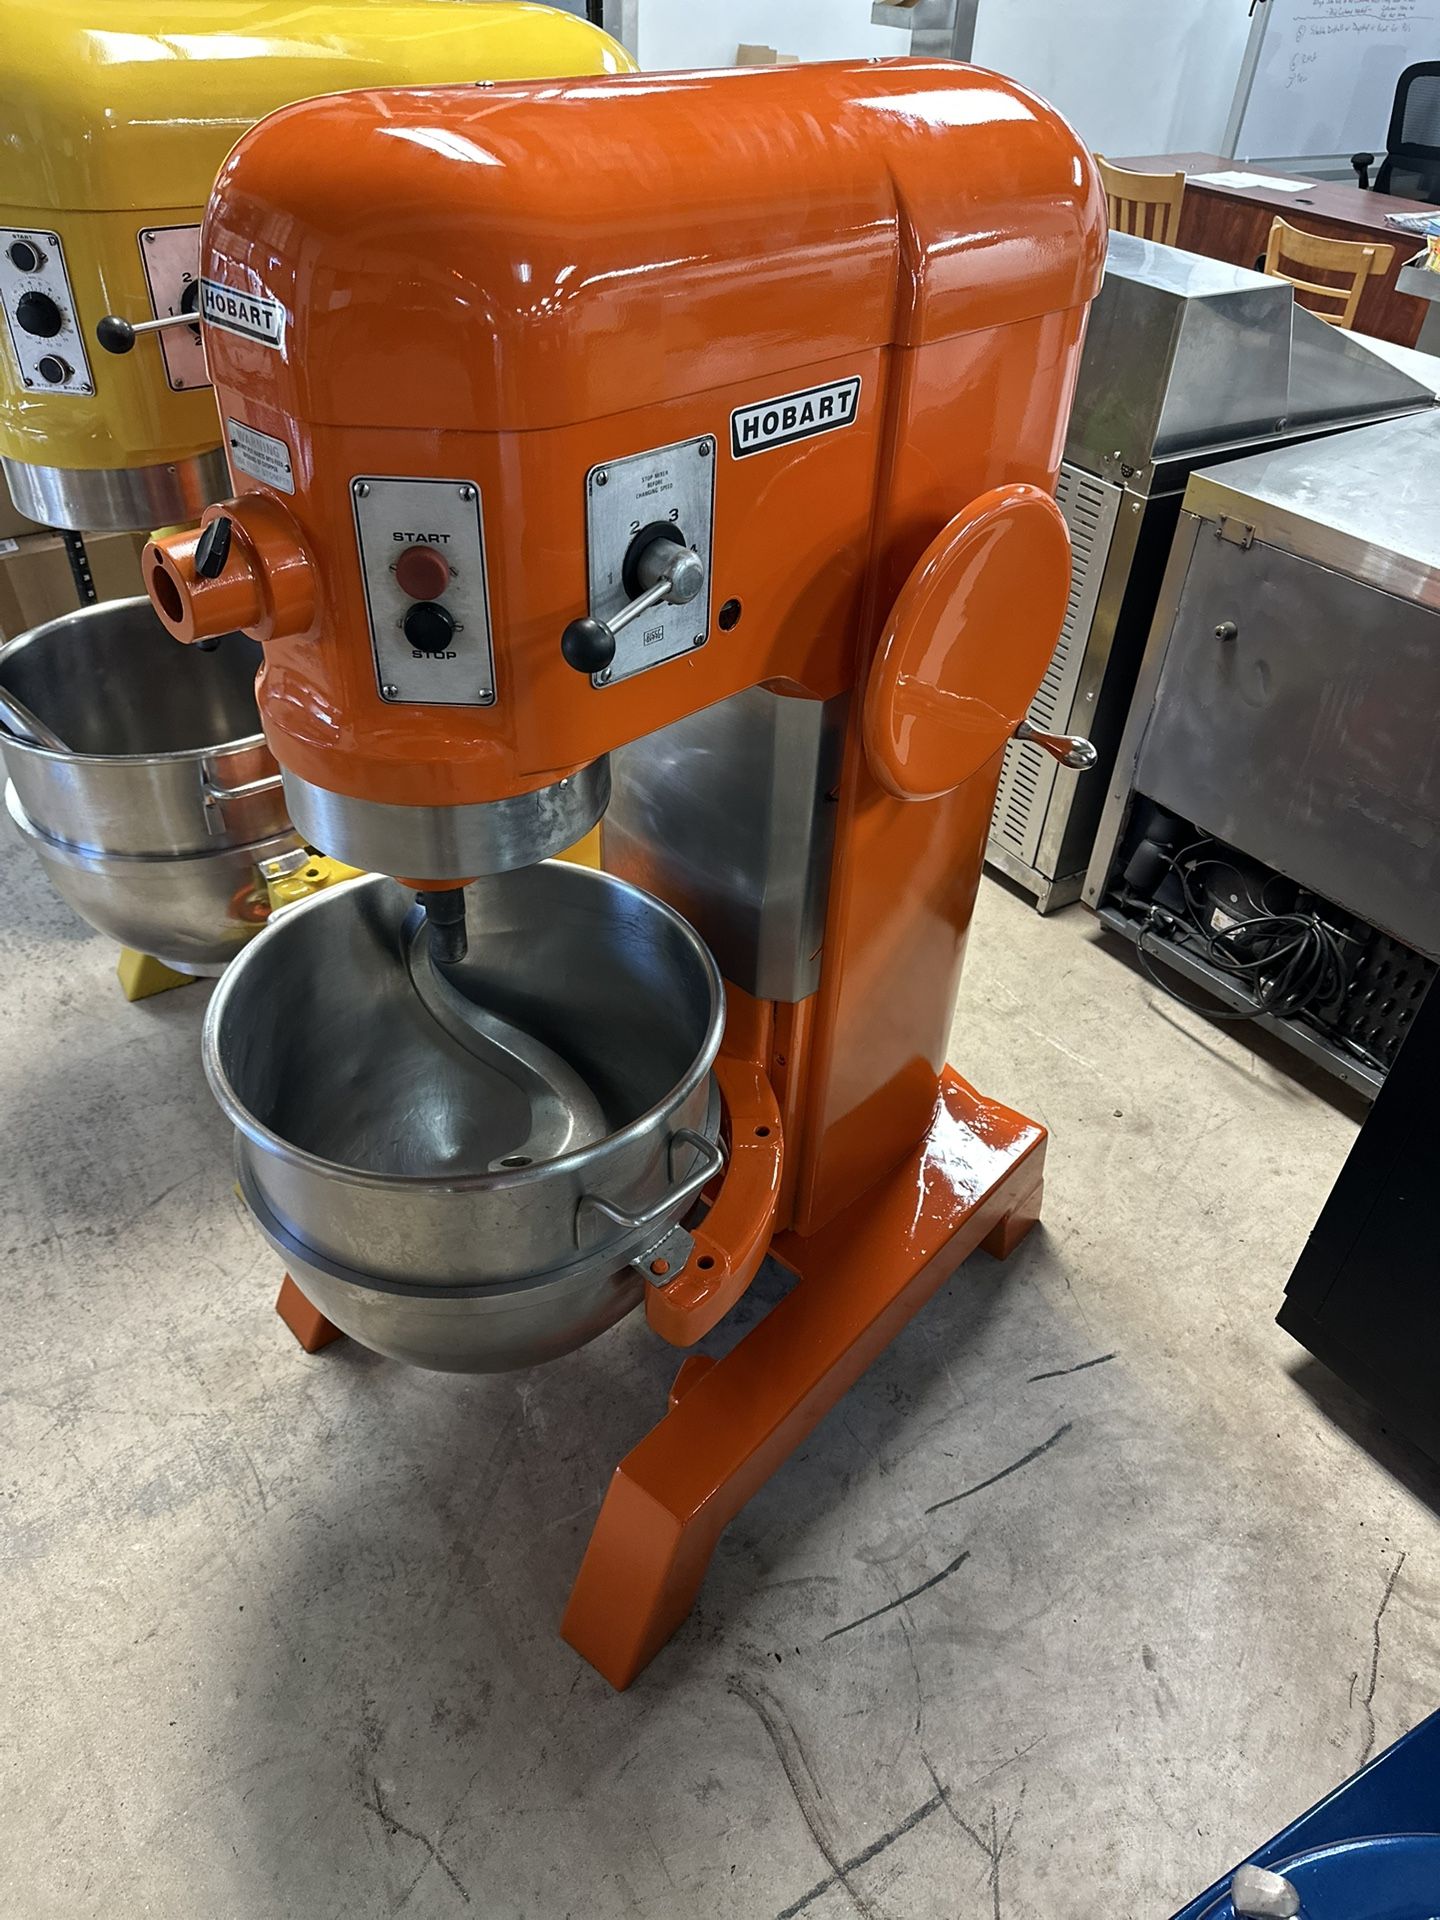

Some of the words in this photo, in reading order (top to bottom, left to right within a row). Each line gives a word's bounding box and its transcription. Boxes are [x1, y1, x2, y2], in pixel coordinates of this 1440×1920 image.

[182, 272, 193, 283] 2
[168, 306, 174, 317] 1
[205, 288, 273, 330] HOBART
[742, 389, 852, 442] HOBART
[641, 474, 653, 483] STOP
[647, 479, 663, 489] BEFORE
[635, 487, 658, 499] CHANGING
[660, 482, 673, 492] SPEED
[668, 508, 679, 522] 3
[630, 520, 641, 535] 2
[392, 532, 451, 544] START
[607, 571, 613, 585] 1
[412, 650, 457, 660] STOP
